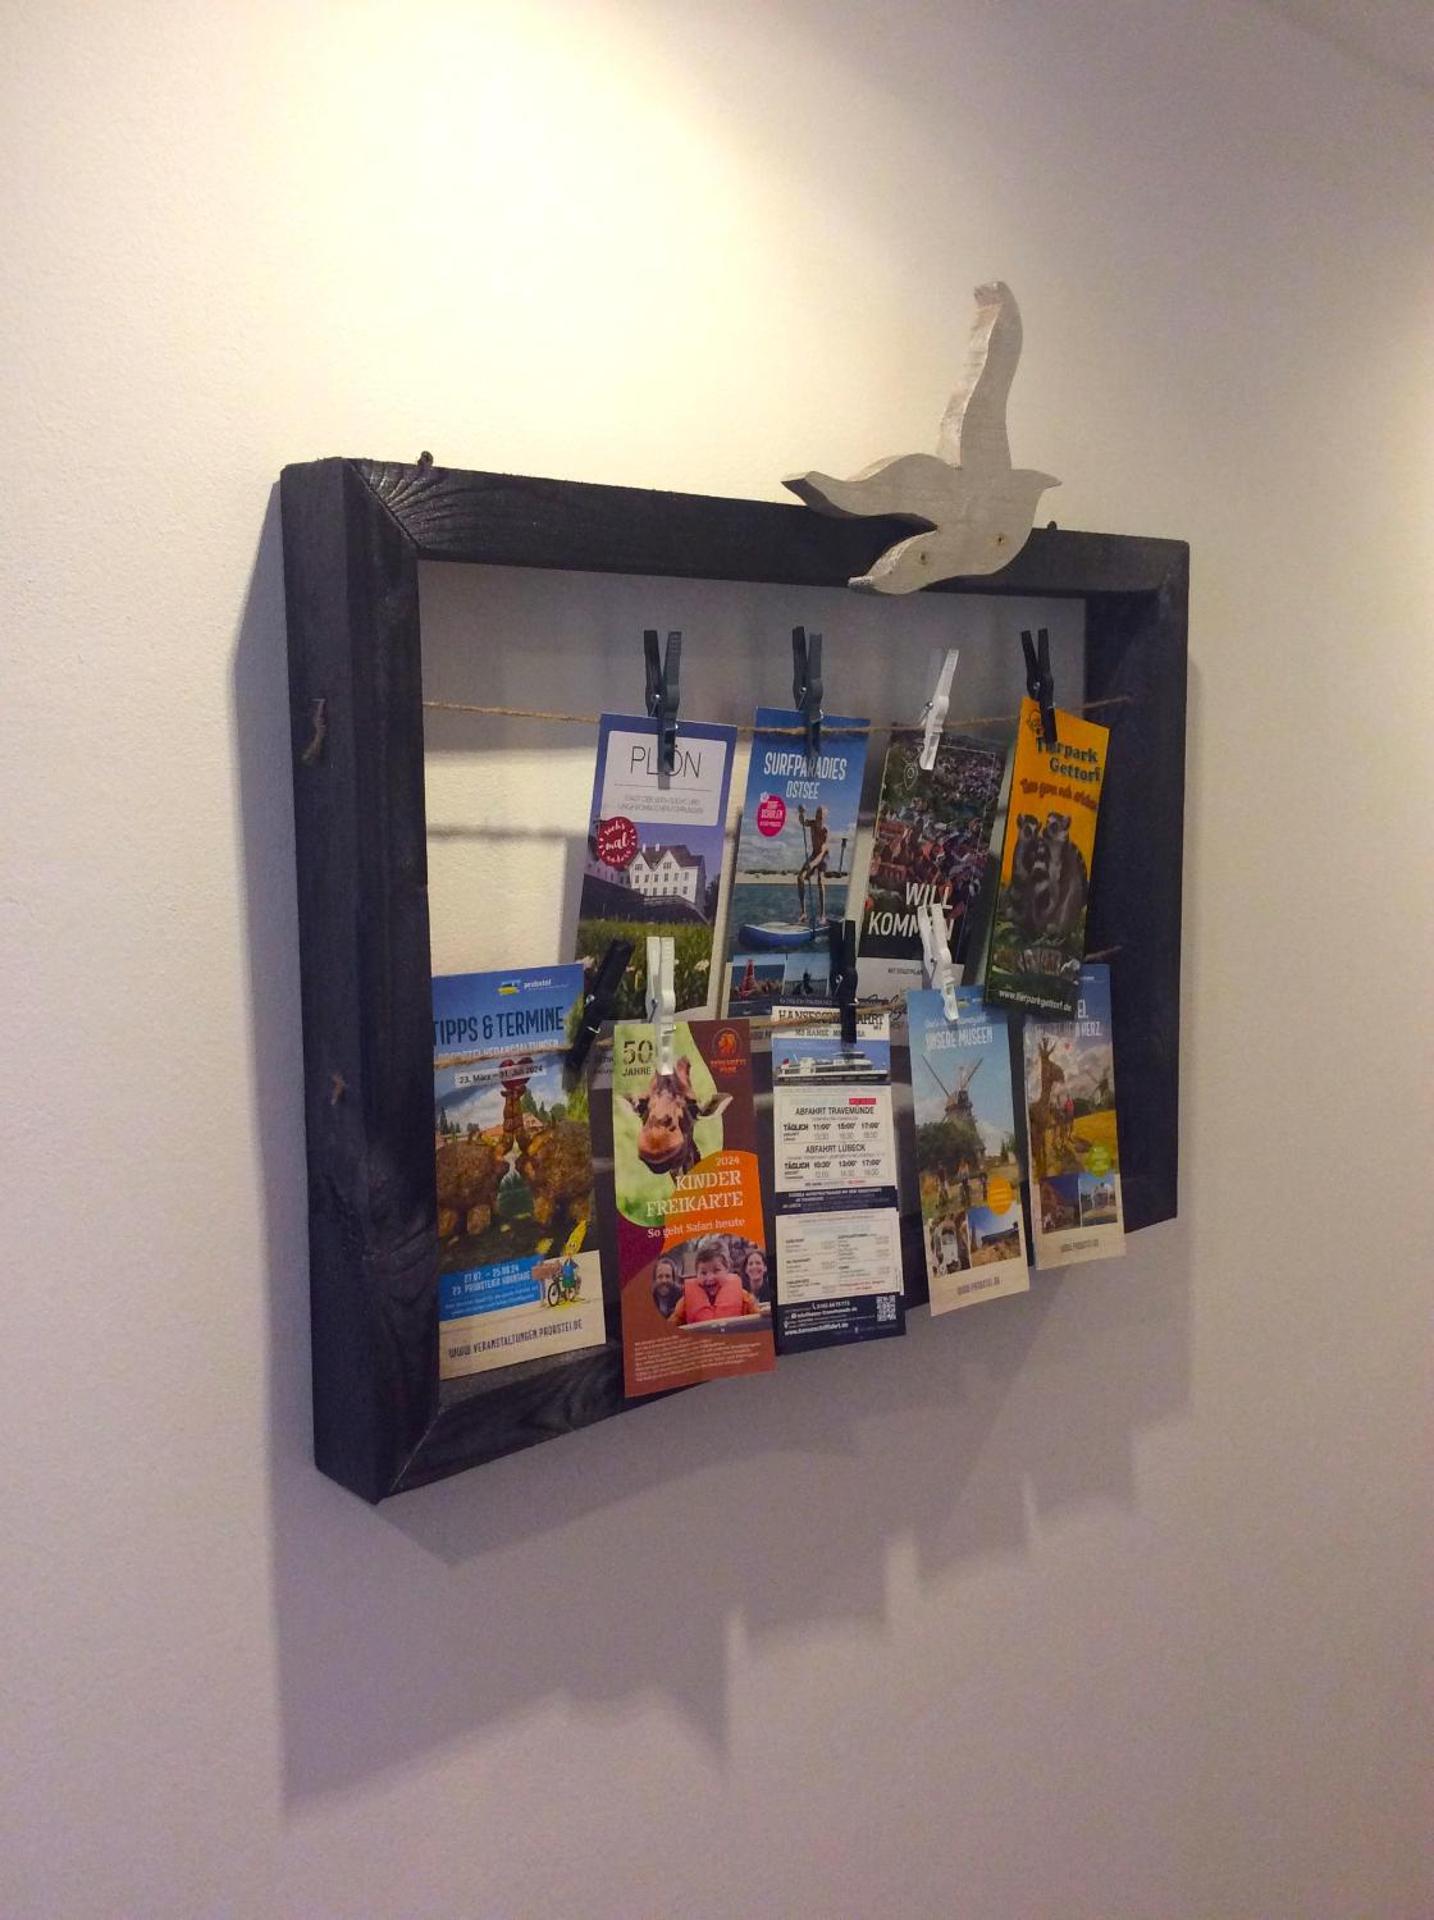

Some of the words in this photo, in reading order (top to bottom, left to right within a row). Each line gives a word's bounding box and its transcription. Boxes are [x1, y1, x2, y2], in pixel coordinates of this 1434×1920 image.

[763, 751, 848, 781] SURFPARADIES
[1049, 757, 1101, 782] Gettorf
[786, 780, 820, 800] OSTSEE
[905, 881, 953, 910] WILL
[868, 911, 955, 941] KOMMN
[433, 1016, 479, 1046] TIPPS
[481, 1014, 493, 1040] &
[495, 1006, 565, 1038] TERMINE
[623, 1039, 654, 1066] 50
[622, 1066, 652, 1078] JAHRE
[796, 1107, 827, 1116] ABFAHRT
[806, 1144, 836, 1154] ABFAHRT
[676, 1170, 742, 1192] KINDER
[647, 1191, 744, 1217] FREIKARTE
[647, 1228, 660, 1239] So
[663, 1224, 684, 1239] geht
[686, 1219, 713, 1233] Safari
[715, 1217, 746, 1229] heute
